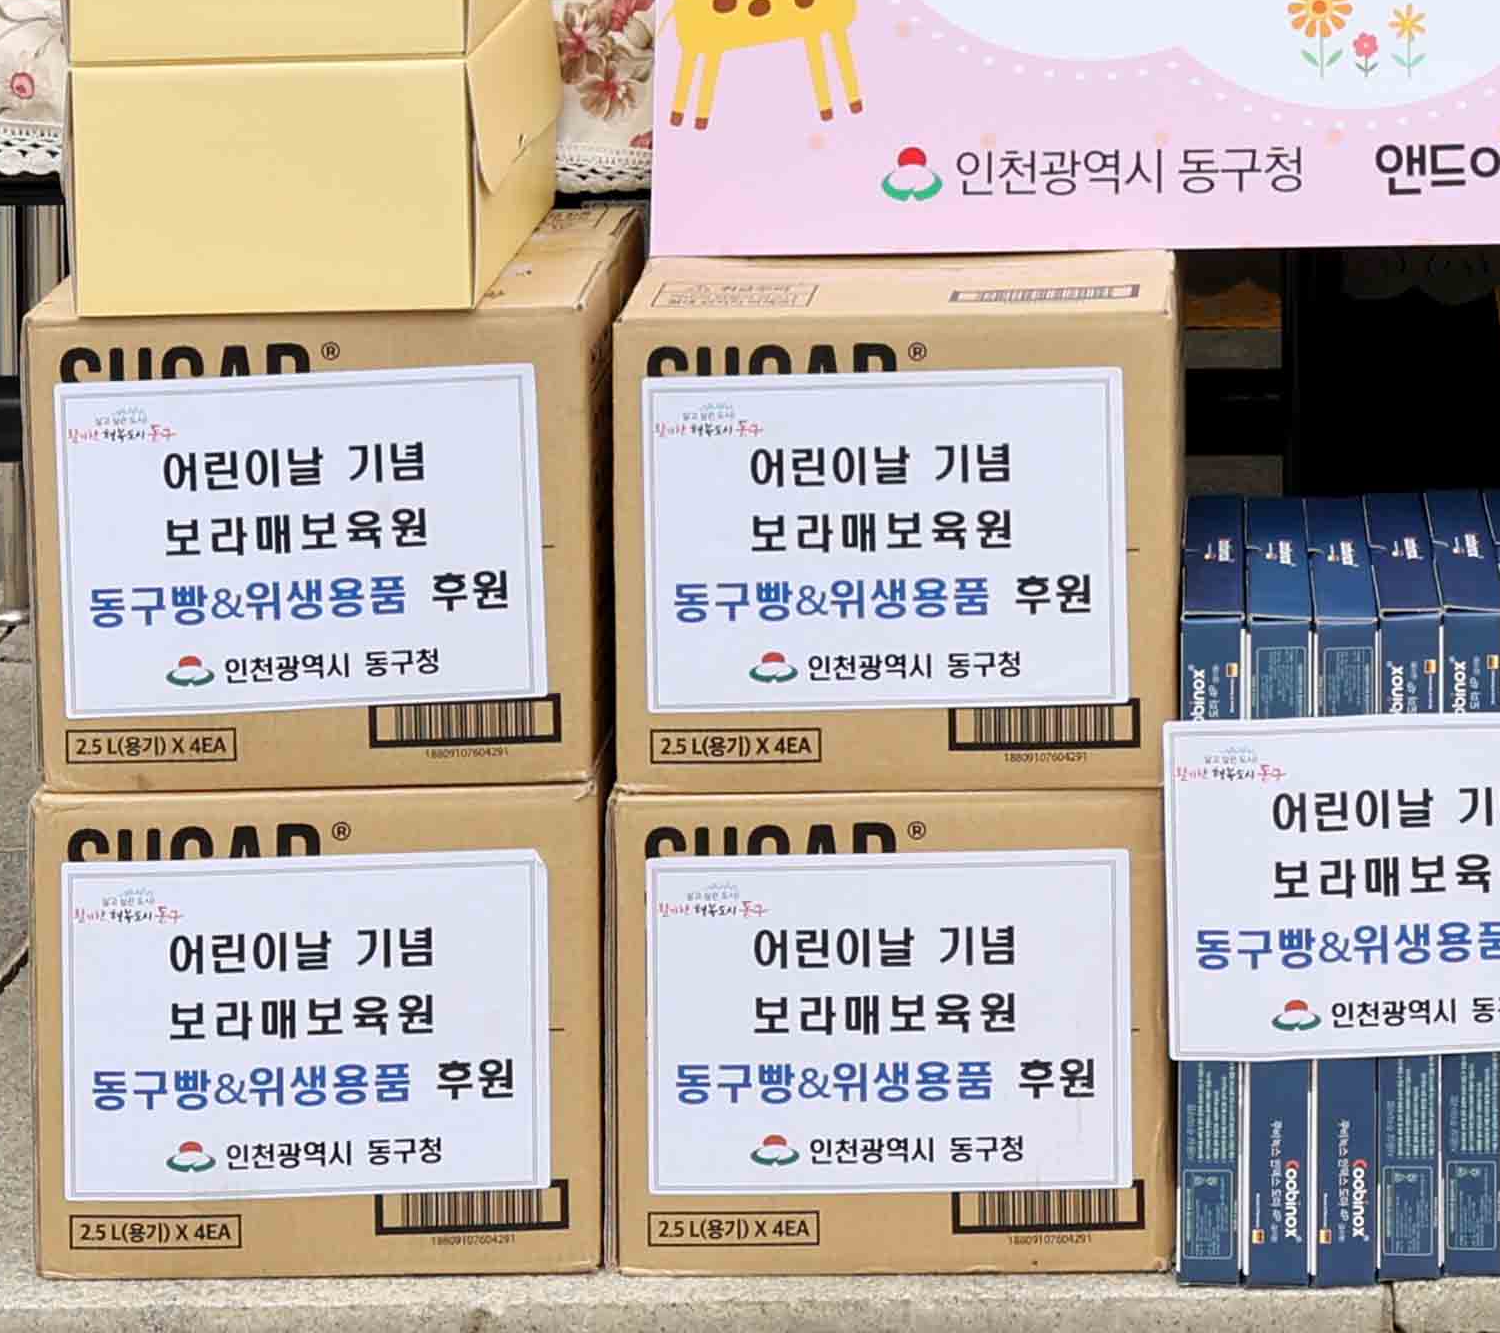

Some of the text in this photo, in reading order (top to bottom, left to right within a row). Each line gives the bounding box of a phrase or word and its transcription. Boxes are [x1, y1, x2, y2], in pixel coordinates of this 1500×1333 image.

[957, 147, 1301, 195] 인천광역시 동구청
[164, 442, 424, 491] 어린이날 기념
[751, 444, 1009, 487] 어린이날 기념
[166, 508, 426, 556] 보라매보육원
[752, 510, 1011, 552] 보라매보육원
[90, 570, 508, 628] 동구빵&위생용품 후원
[674, 575, 1090, 623] 동구빵&위생용품 후원
[225, 648, 438, 683] 인천광역시 동구청
[809, 651, 1020, 681] 인천광역시 동구청
[75, 738, 102, 755] 2.5
[171, 737, 185, 754] X
[189, 736, 227, 754] 4EA
[1273, 788, 1433, 832] 어린이날
[170, 927, 432, 974] 어린이날 기념
[754, 926, 1014, 969] 어린이날 기념
[170, 995, 433, 1040] 보라매보육원
[754, 993, 1015, 1035] 보라매보육원
[1332, 998, 1455, 1028] 인천광역시
[92, 1059, 513, 1110] 동구빵&위생용품 후원
[676, 1059, 1094, 1104] 동구빵&위생용품 후원
[227, 1137, 441, 1170] 인천광역시 동구청
[810, 1136, 1023, 1164] 인천광역시 동구청
